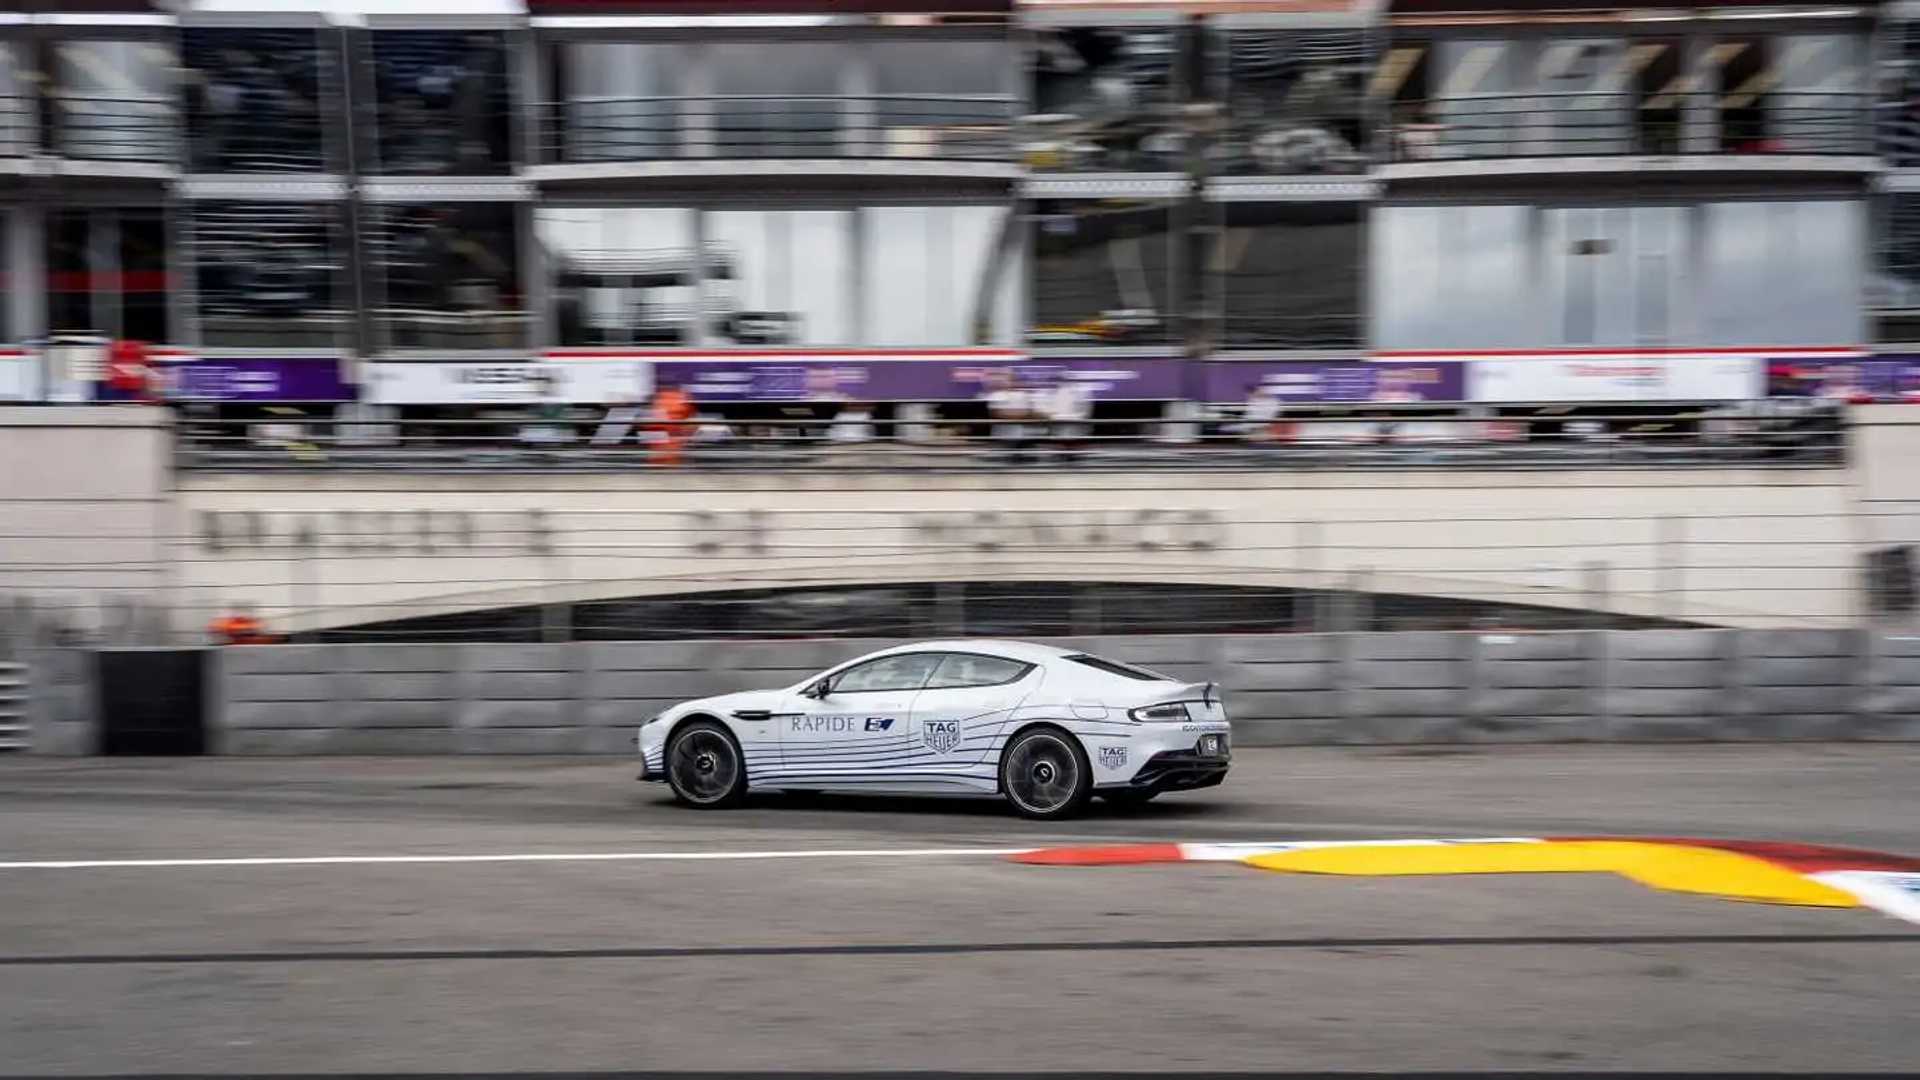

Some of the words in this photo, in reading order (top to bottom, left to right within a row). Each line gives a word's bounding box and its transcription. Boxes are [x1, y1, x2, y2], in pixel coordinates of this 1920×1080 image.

[791, 716, 856, 732] RAPIDE
[926, 722, 956, 733] TAG
[926, 734, 958, 749] HEUER
[1102, 747, 1124, 756] TAG
